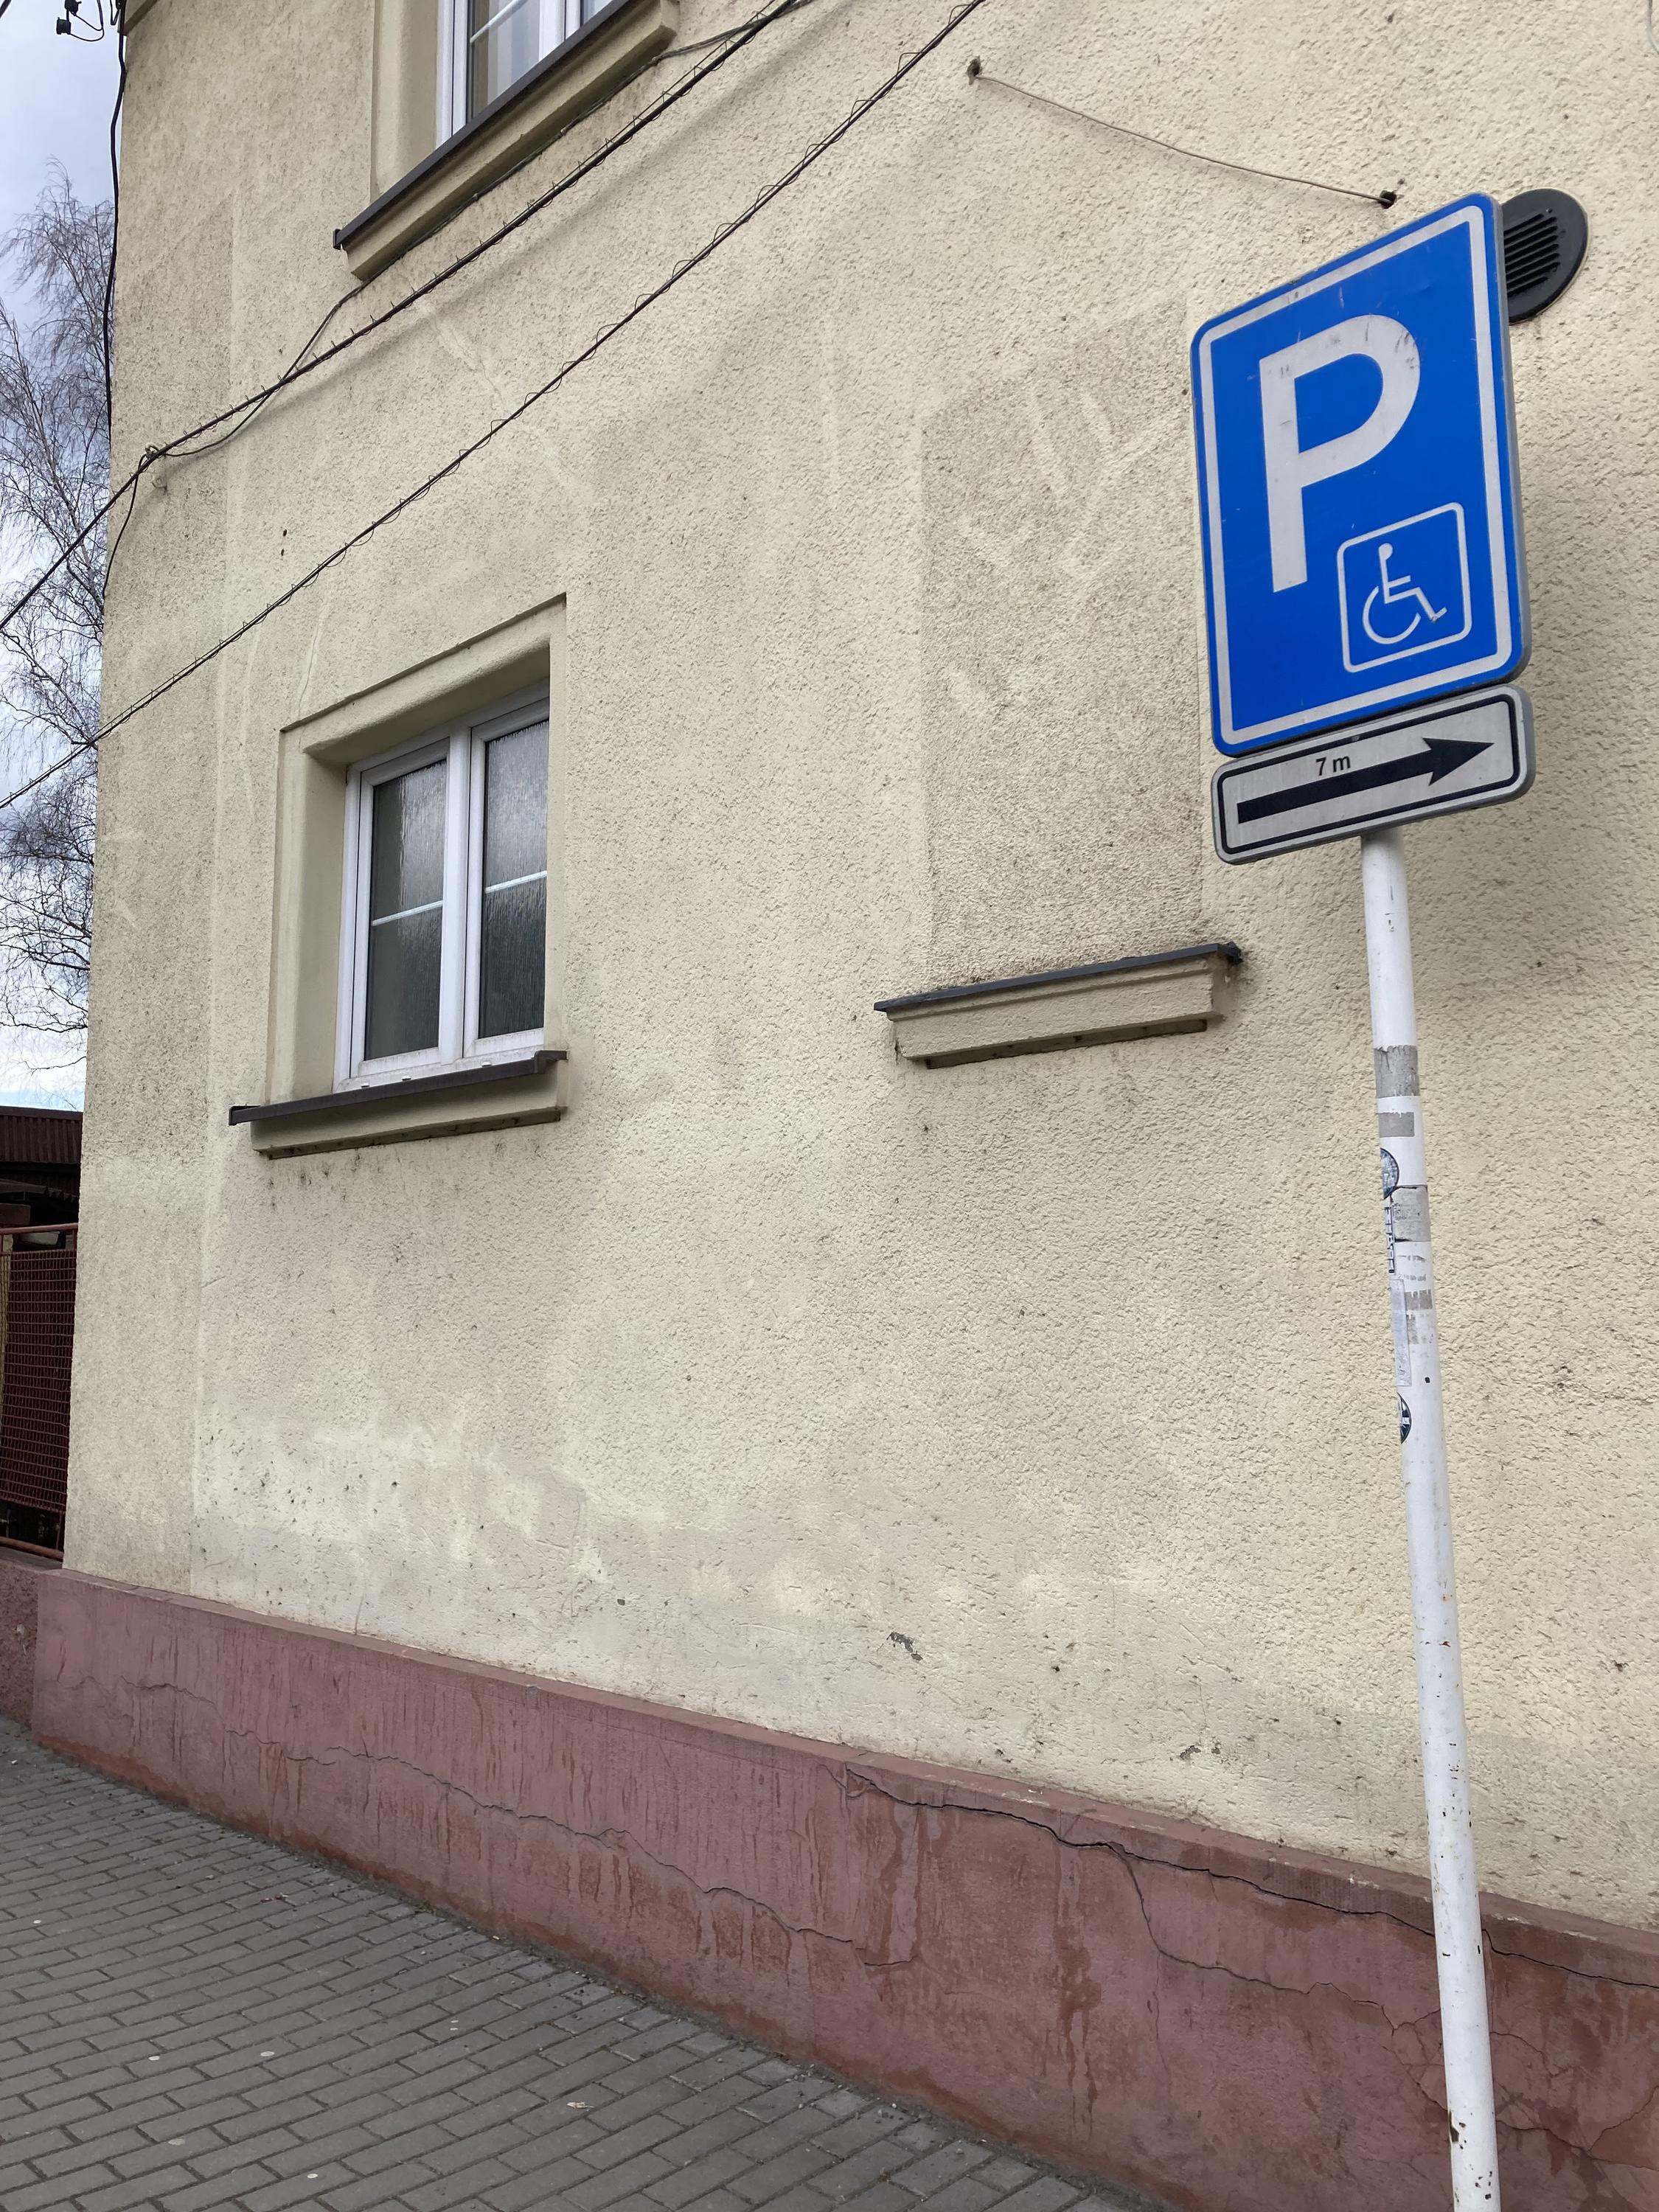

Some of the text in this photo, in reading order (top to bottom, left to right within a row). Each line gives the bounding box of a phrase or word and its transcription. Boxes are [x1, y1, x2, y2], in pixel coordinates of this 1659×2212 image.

[1259, 314, 1420, 593] P
[1316, 756, 1351, 776] 7 m
